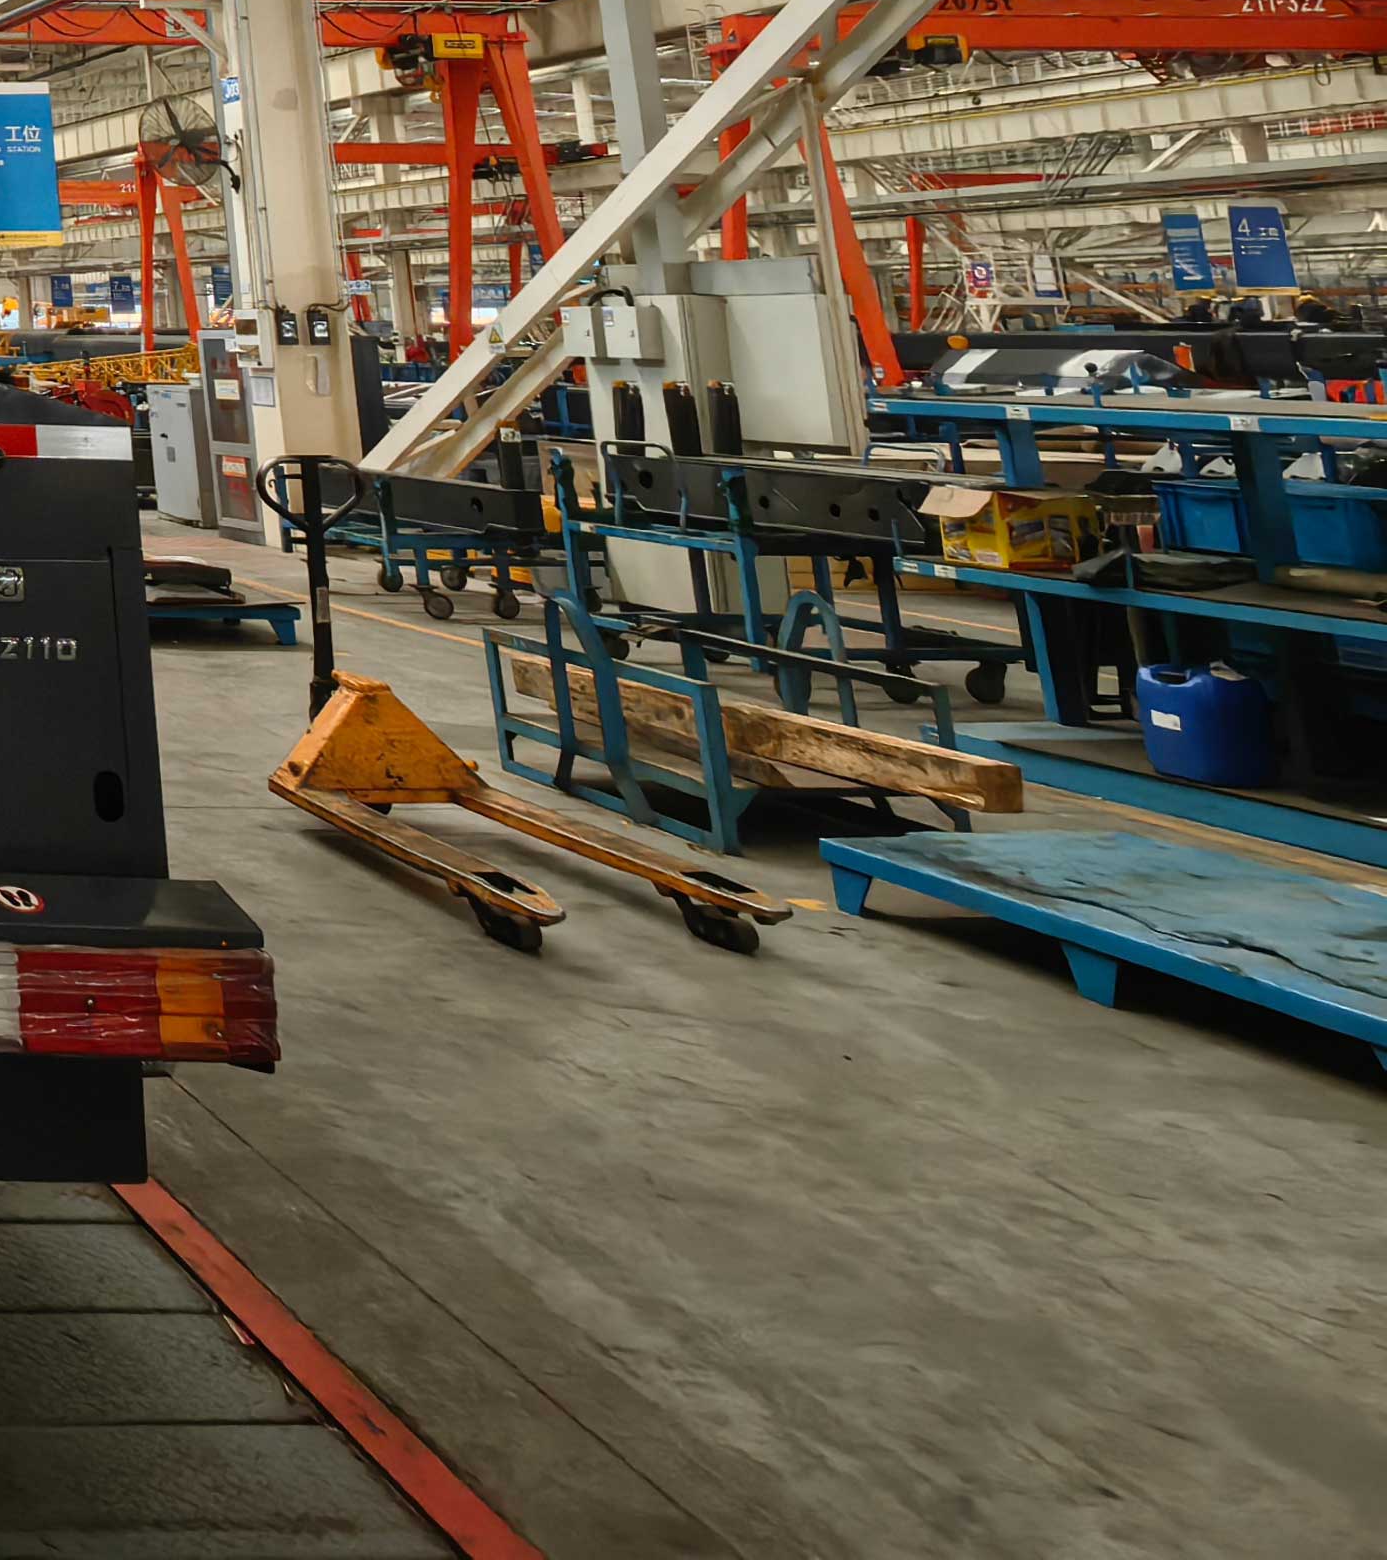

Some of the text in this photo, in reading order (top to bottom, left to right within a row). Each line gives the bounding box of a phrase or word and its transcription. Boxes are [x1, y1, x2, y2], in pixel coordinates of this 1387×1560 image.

[4, 125, 43, 143] 工位
[6, 145, 42, 153] STATION
[1237, 217, 1251, 237] 4
